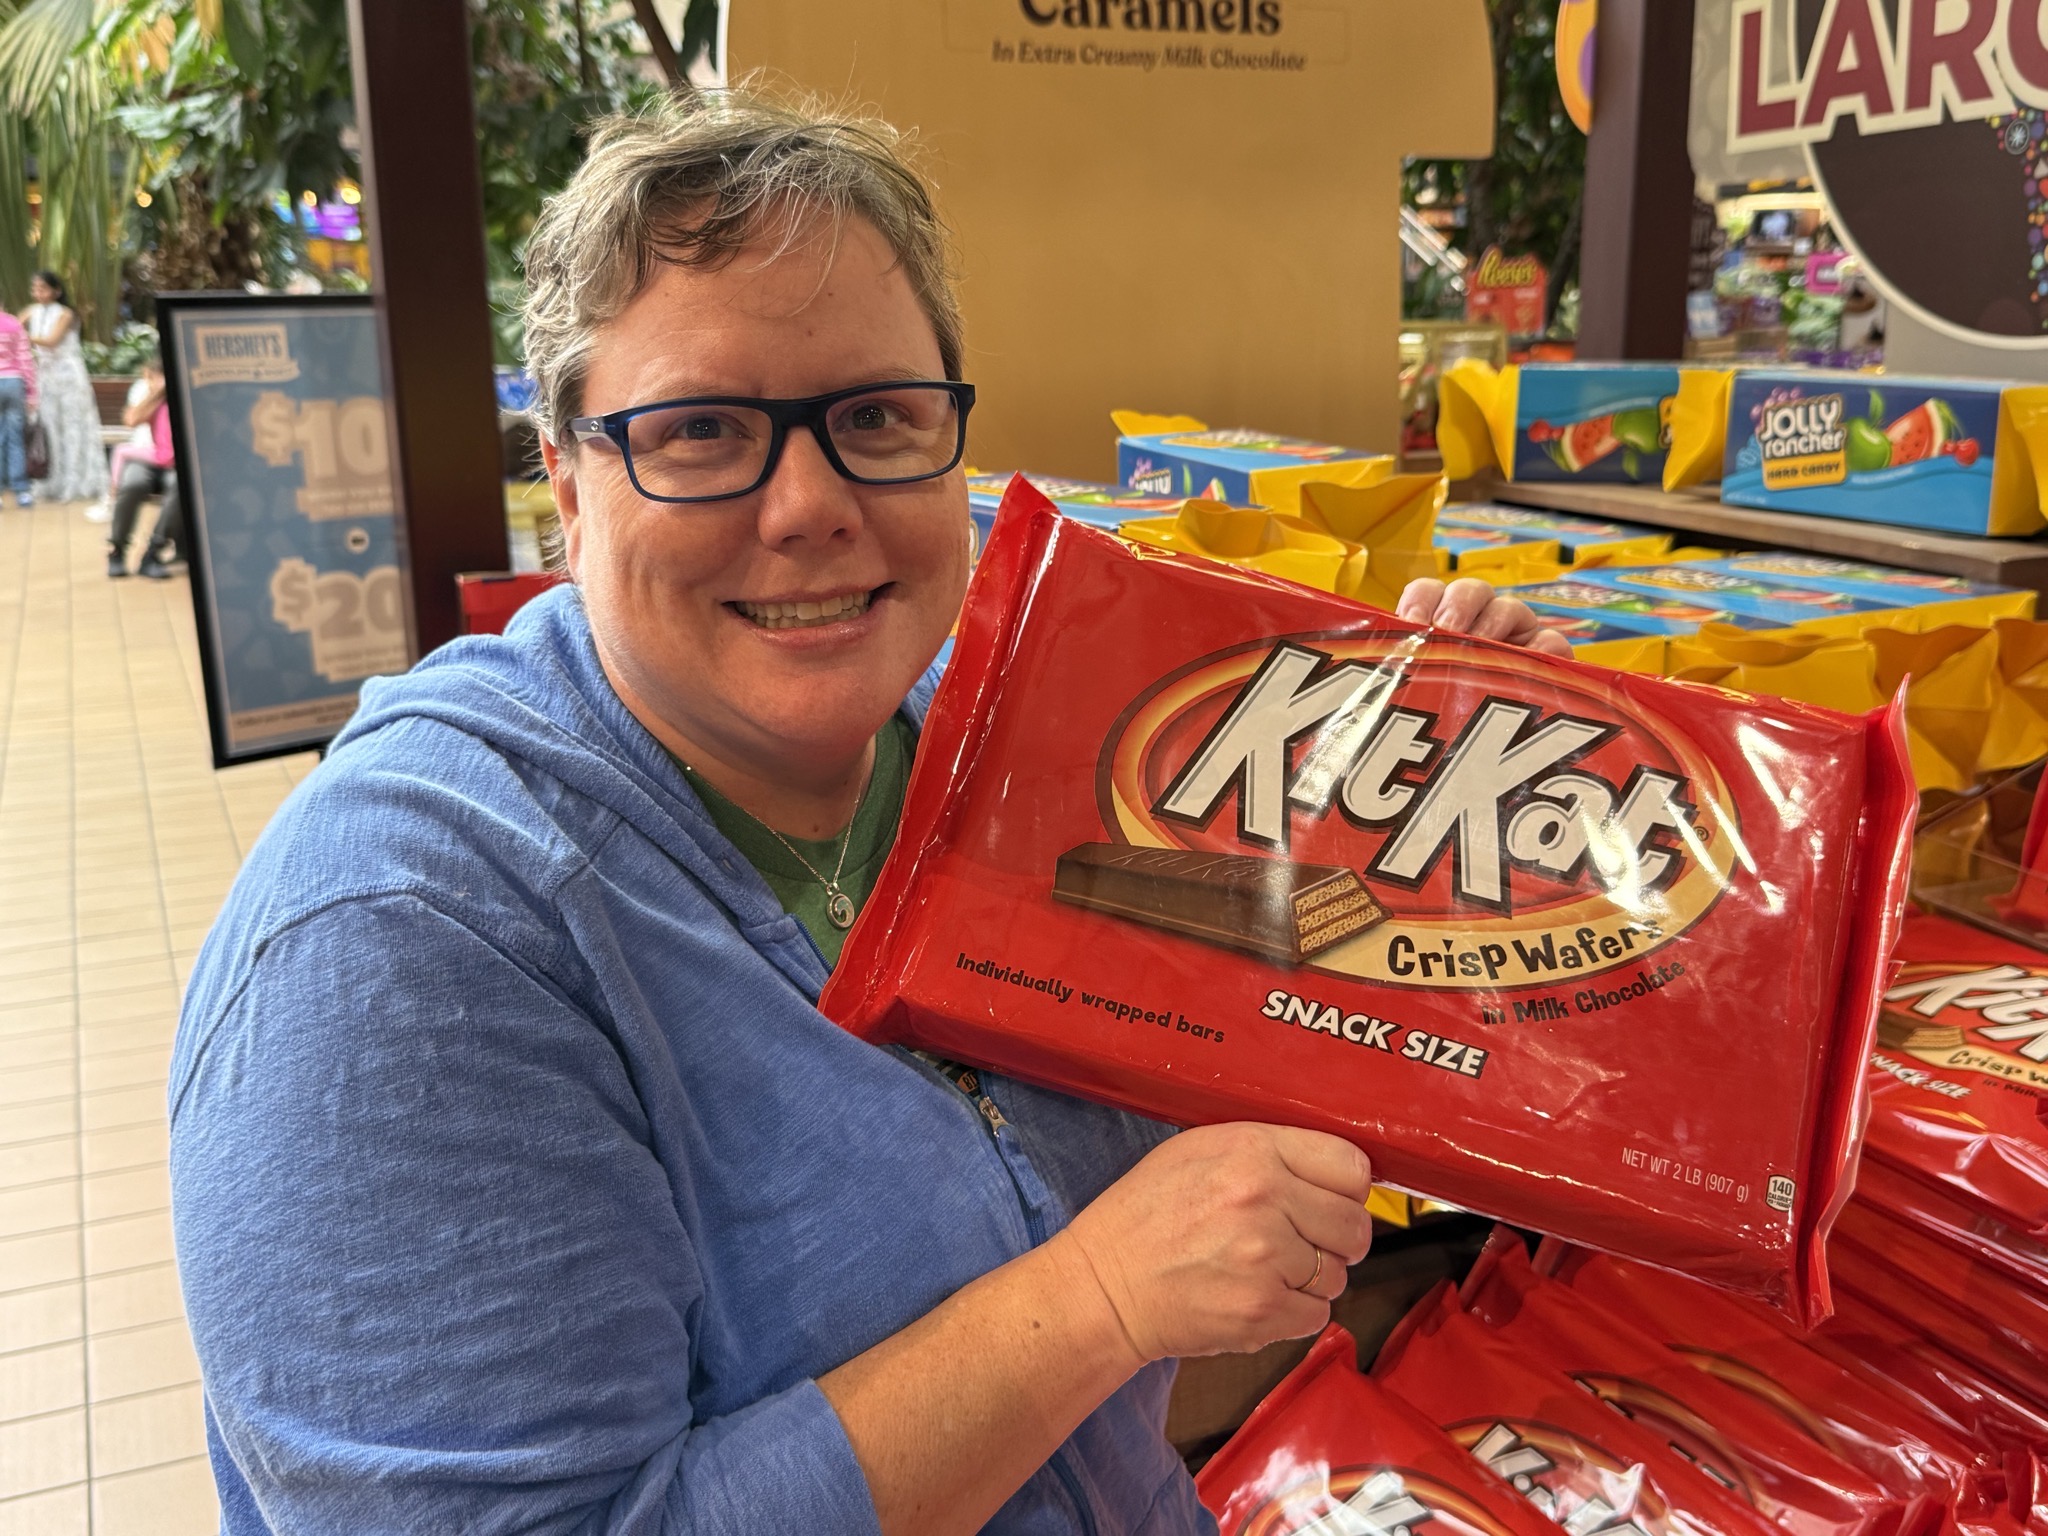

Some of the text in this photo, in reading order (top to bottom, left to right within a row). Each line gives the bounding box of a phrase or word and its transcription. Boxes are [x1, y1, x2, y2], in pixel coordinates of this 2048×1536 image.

[1020, 0, 1281, 36] Caramels
[993, 41, 1306, 71] In Extra Creamy Milk Chocolate
[256, 397, 391, 479] $10
[1761, 399, 1841, 441] JOLLY
[1764, 429, 1844, 459] rancher
[1766, 465, 1799, 481] HARD
[1387, 918, 1664, 981] Crisp Wafers
[955, 952, 1226, 1044] Individually wrapped bars
[1482, 960, 1686, 1026] in Milk Chocolate
[1260, 988, 1489, 1079] SNACK SIZE
[1948, 1050, 2022, 1077] Crisp
[1922, 1078, 1973, 1100] SIZE
[1621, 1147, 1749, 1203] NET WT 2 LB (907 g)
[1771, 1179, 1793, 1197] 140
